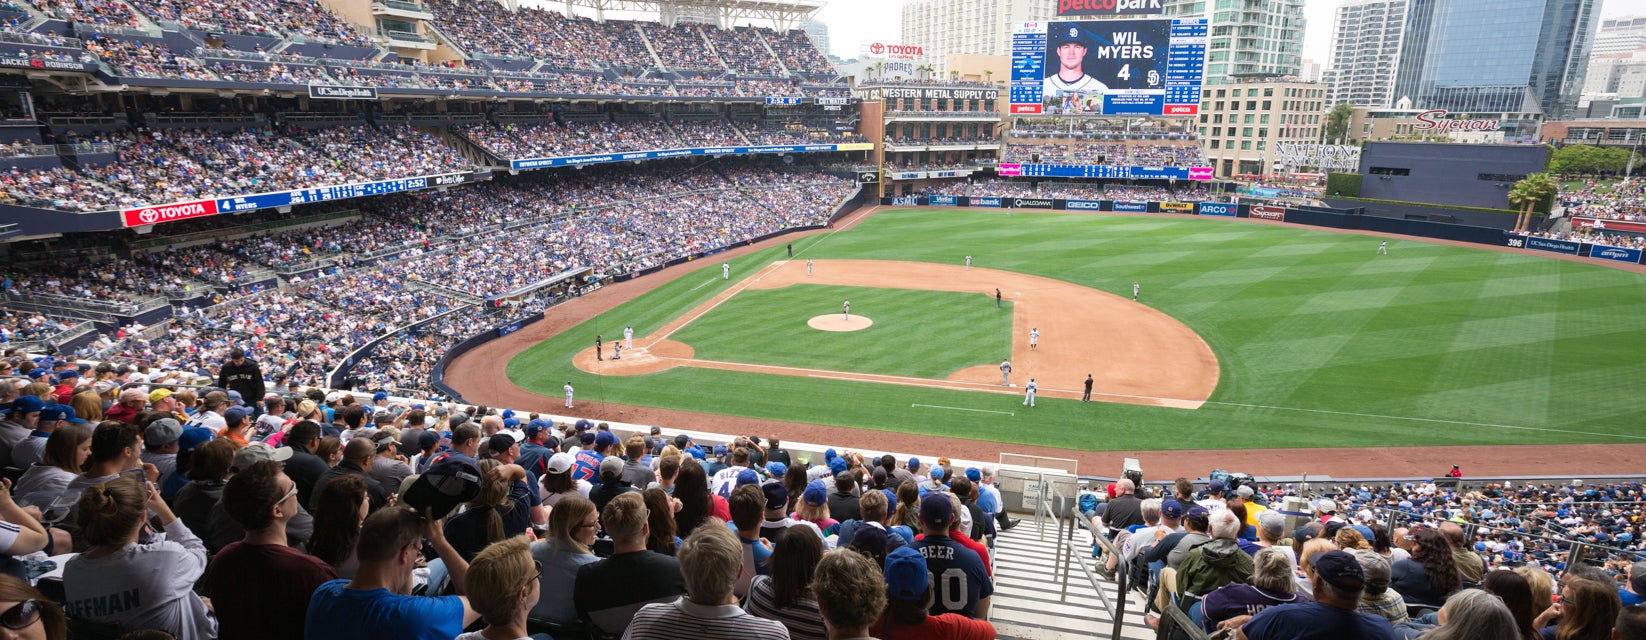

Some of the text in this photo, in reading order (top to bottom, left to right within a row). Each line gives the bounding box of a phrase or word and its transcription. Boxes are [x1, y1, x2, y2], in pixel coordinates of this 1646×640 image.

[1112, 32, 1141, 44] WIL
[887, 45, 924, 55] TOYOTA
[1098, 46, 1154, 58] MYERS
[1, 58, 84, 70] JACKIE 42 ROBINSON
[884, 62, 912, 75] PADRES
[1118, 64, 1130, 80] 4
[338, 88, 354, 97] Diego
[882, 88, 922, 98] WESTERN
[926, 89, 952, 98] METAL
[954, 90, 982, 100] SUPPLY
[986, 91, 998, 100] CO.
[1414, 110, 1500, 134] Sycuan
[222, 201, 230, 210] 4
[1016, 199, 1051, 208] QUALCOMM
[158, 204, 205, 219] TOYOTA
[1201, 206, 1226, 214] ARCO
[1252, 207, 1280, 218] Sycuan
[1508, 239, 1522, 247] 396
